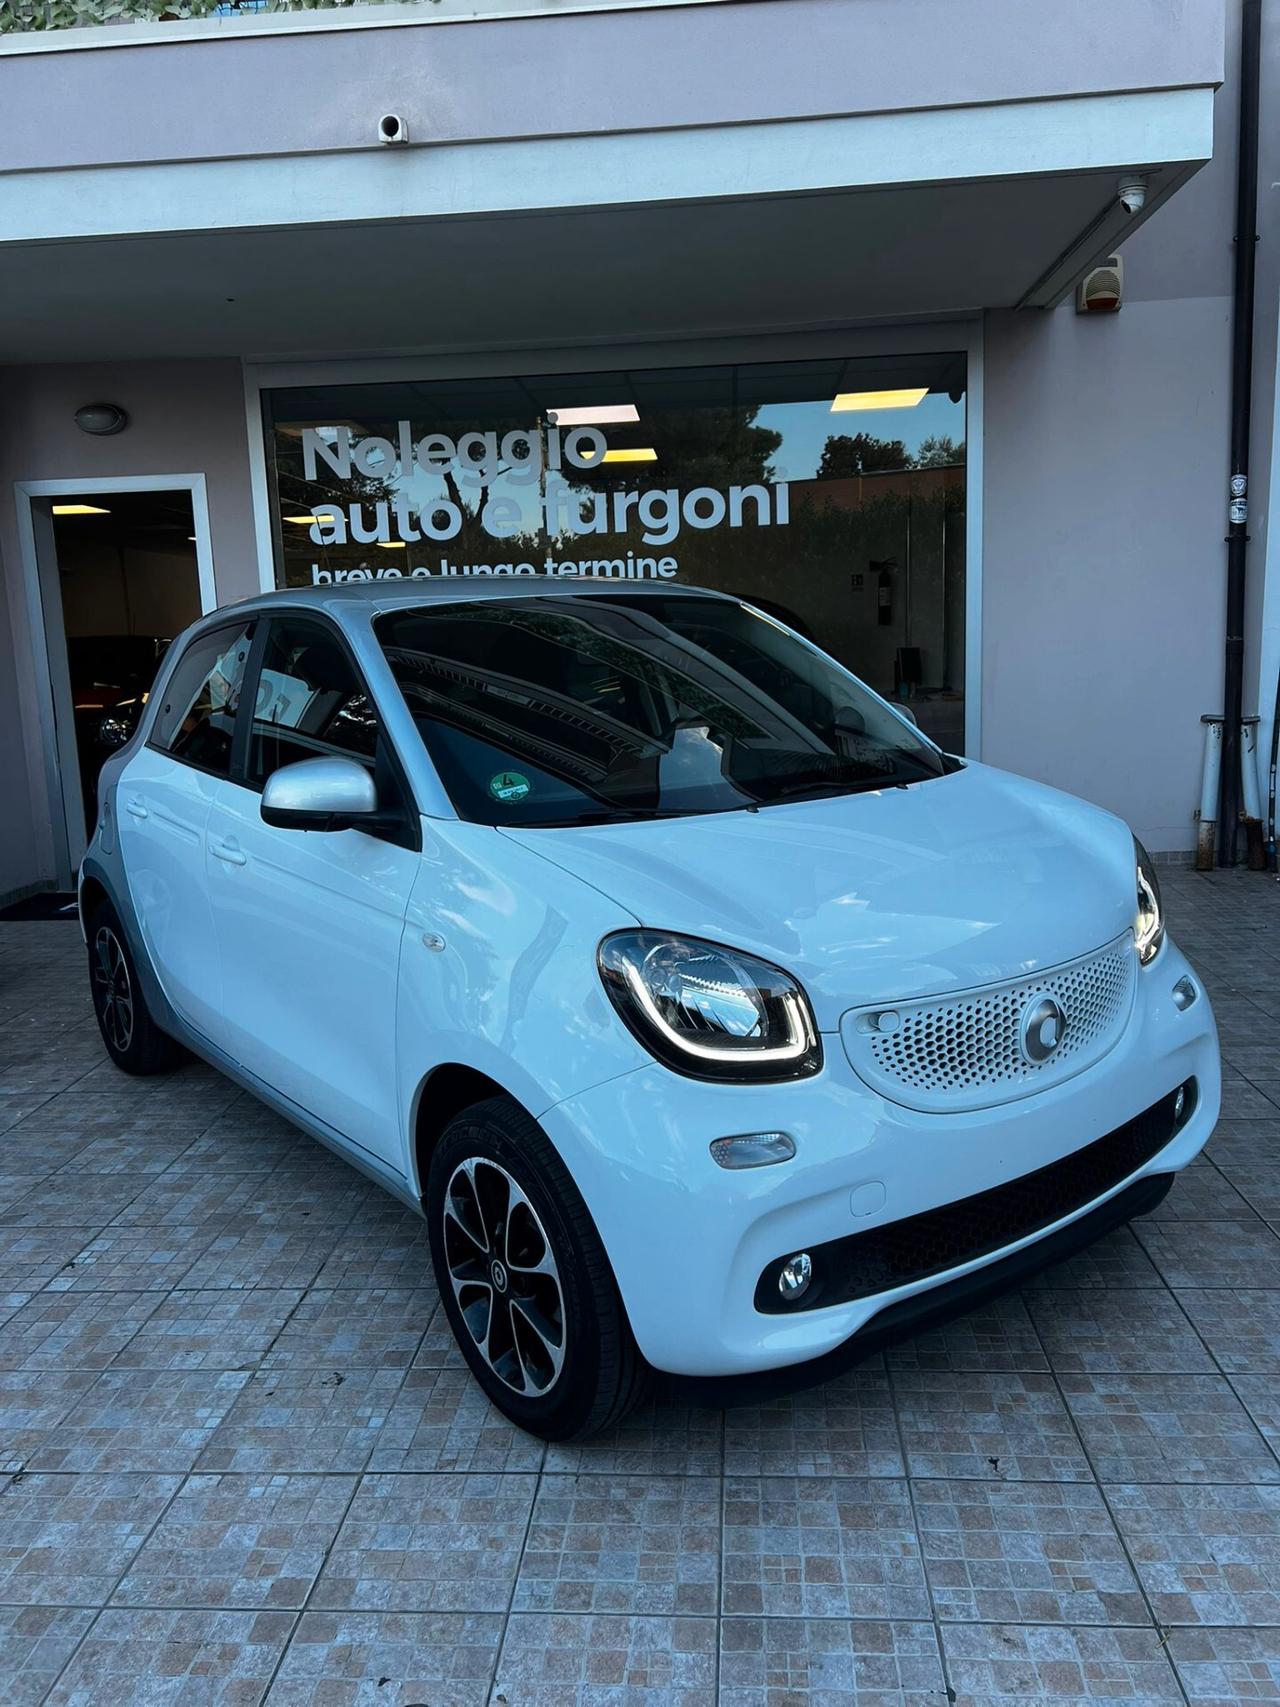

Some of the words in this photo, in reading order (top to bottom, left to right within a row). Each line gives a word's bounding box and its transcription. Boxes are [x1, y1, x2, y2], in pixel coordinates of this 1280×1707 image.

[302, 411, 607, 488] Noleggio
[309, 493, 463, 546] auto
[481, 497, 521, 538] e
[541, 466, 789, 546] furgoni
[544, 551, 678, 578] termine
